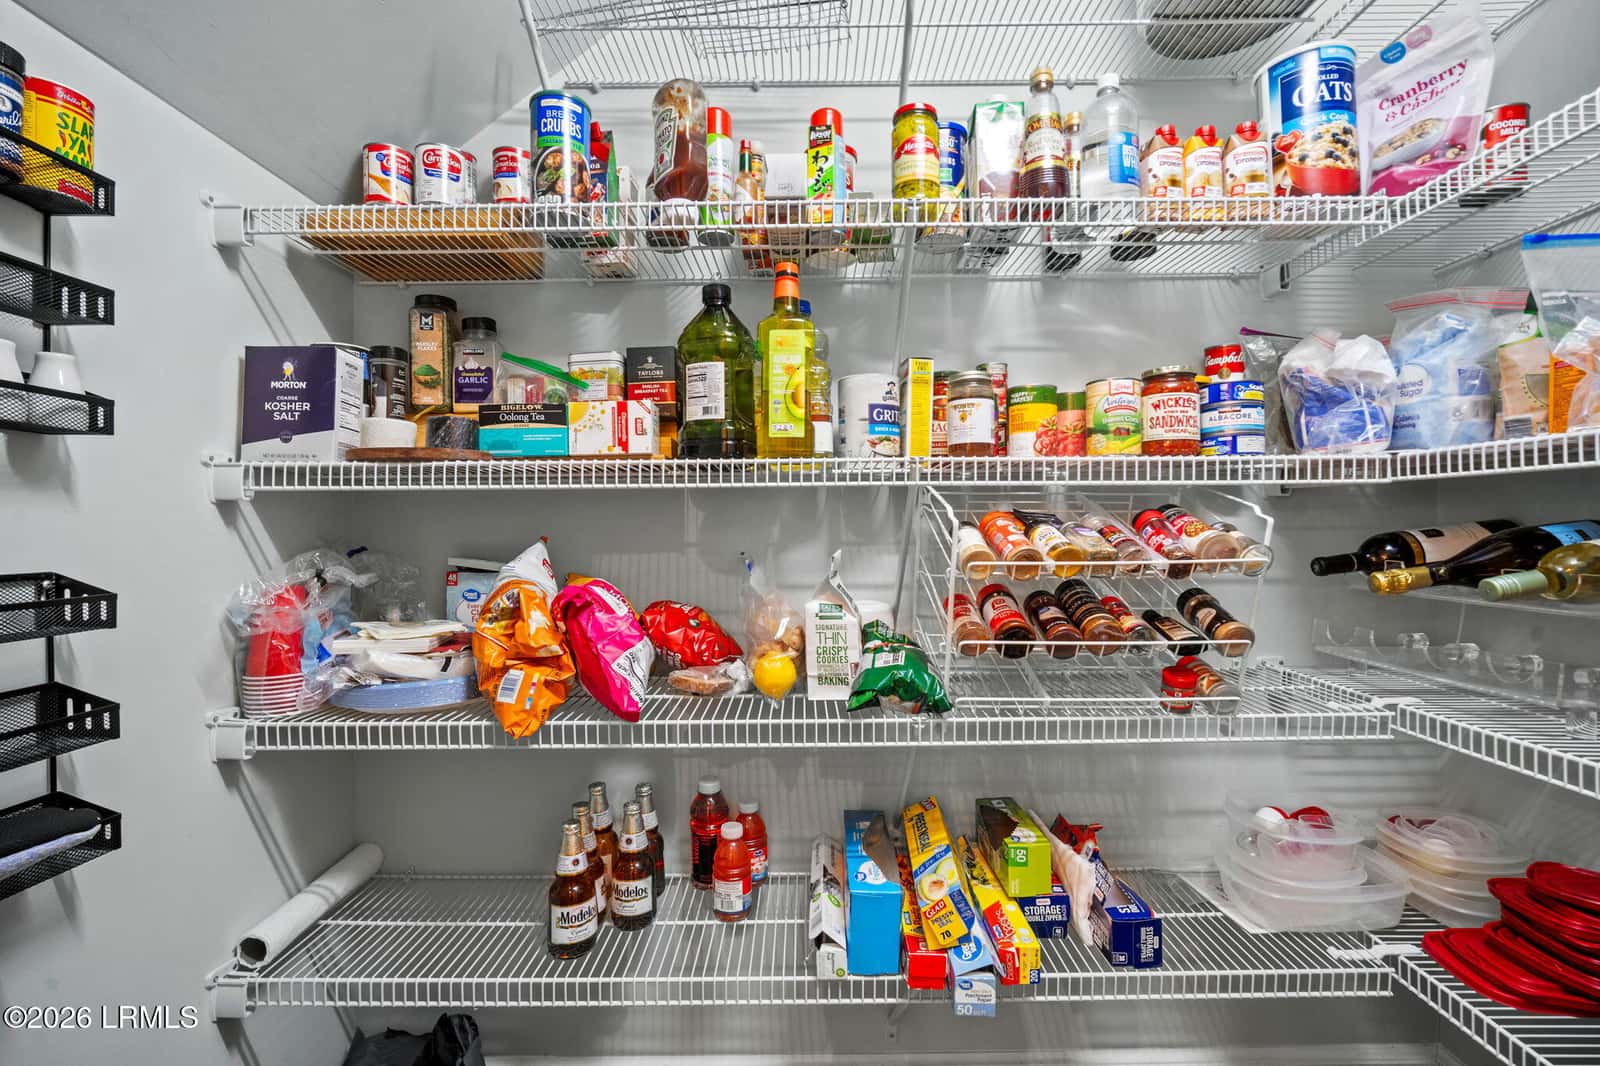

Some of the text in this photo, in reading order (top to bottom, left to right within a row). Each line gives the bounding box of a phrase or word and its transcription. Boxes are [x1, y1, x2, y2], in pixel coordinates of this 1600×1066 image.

[1378, 58, 1468, 111] Cranberry
[1292, 81, 1353, 108] OATS
[546, 110, 577, 122] BRED
[56, 111, 95, 139] SLAP
[1501, 127, 1521, 136] MILK
[69, 133, 87, 155] YA
[424, 151, 461, 168] Carnion
[812, 150, 830, 193] わさび
[271, 381, 306, 389] MORTON
[458, 376, 488, 384] GARLIC
[1399, 388, 1424, 398] Sugar
[264, 402, 311, 411] KOSHER
[273, 412, 300, 421] SALT
[500, 412, 545, 423] Oolong Tea
[873, 408, 900, 422] GRIT
[1208, 413, 1252, 422] ALBACORE
[815, 632, 848, 645] THIN
[816, 646, 849, 656] CRISPY
[816, 655, 849, 664] COOKIES
[817, 676, 849, 686] BAKING
[1016, 849, 1027, 863] 50
[926, 900, 945, 919] GLAD
[1024, 905, 1061, 915] STORAGE
[940, 929, 952, 940] 70
[1145, 927, 1154, 962] STORAGE
[1030, 970, 1039, 983] 200
[956, 1004, 973, 1016] 50
